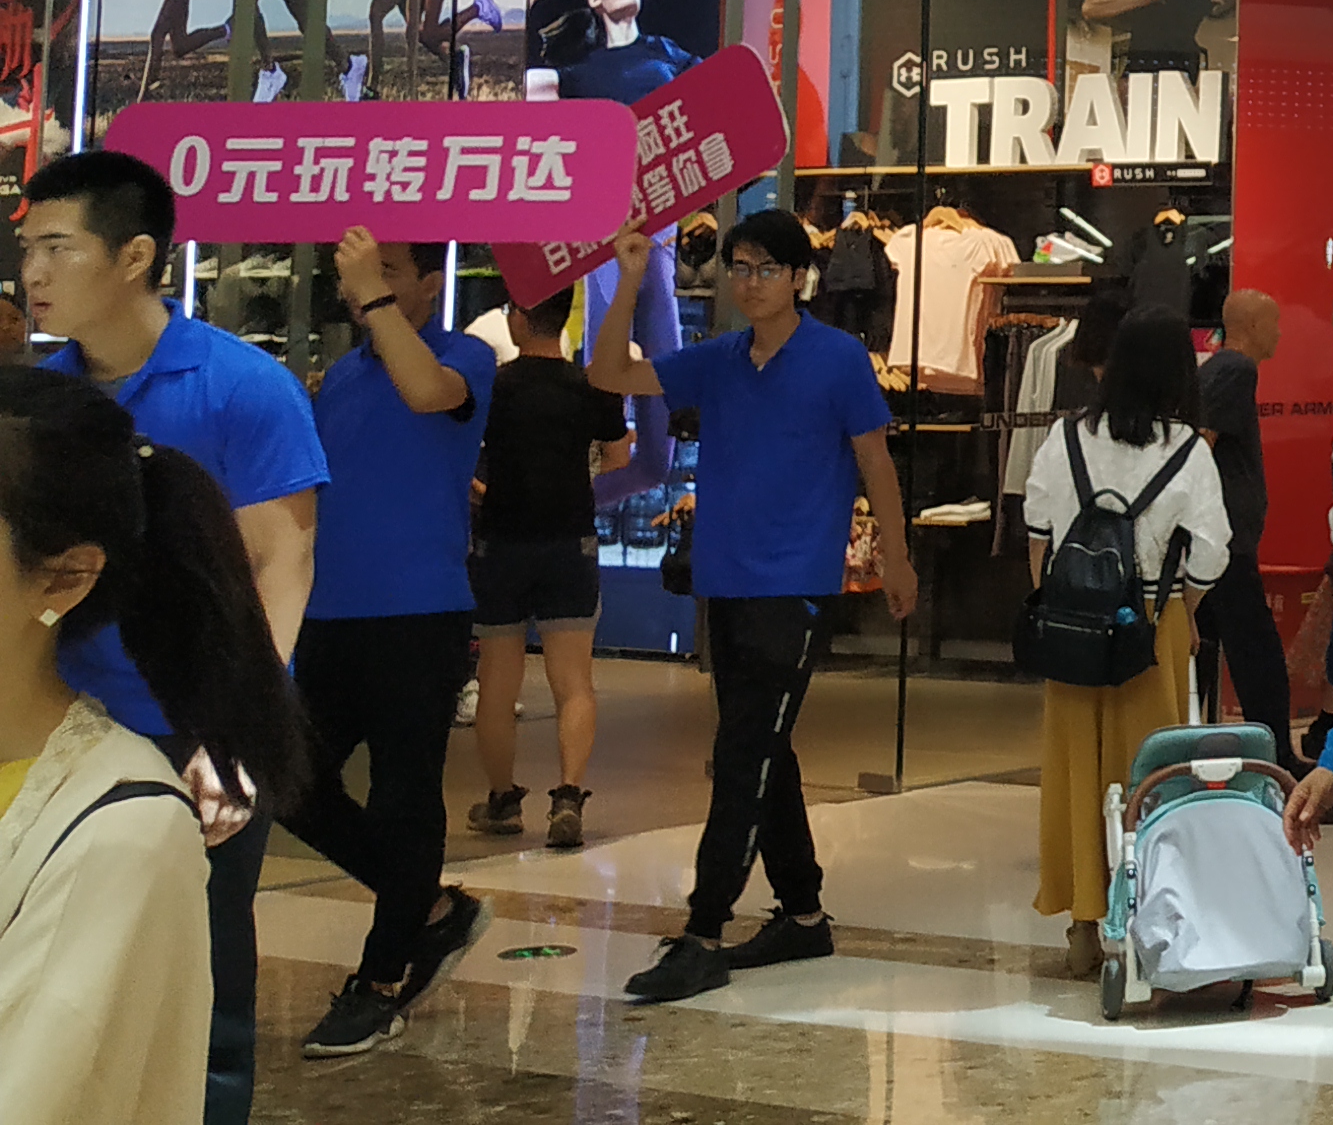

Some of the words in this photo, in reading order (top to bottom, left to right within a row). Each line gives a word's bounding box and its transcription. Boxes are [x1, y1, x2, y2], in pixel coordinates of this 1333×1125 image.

[932, 46, 1028, 72] RUSH
[929, 70, 1223, 167] TRAIN
[169, 134, 578, 205] 0元玩转万达
[1114, 168, 1155, 180] RUSH
